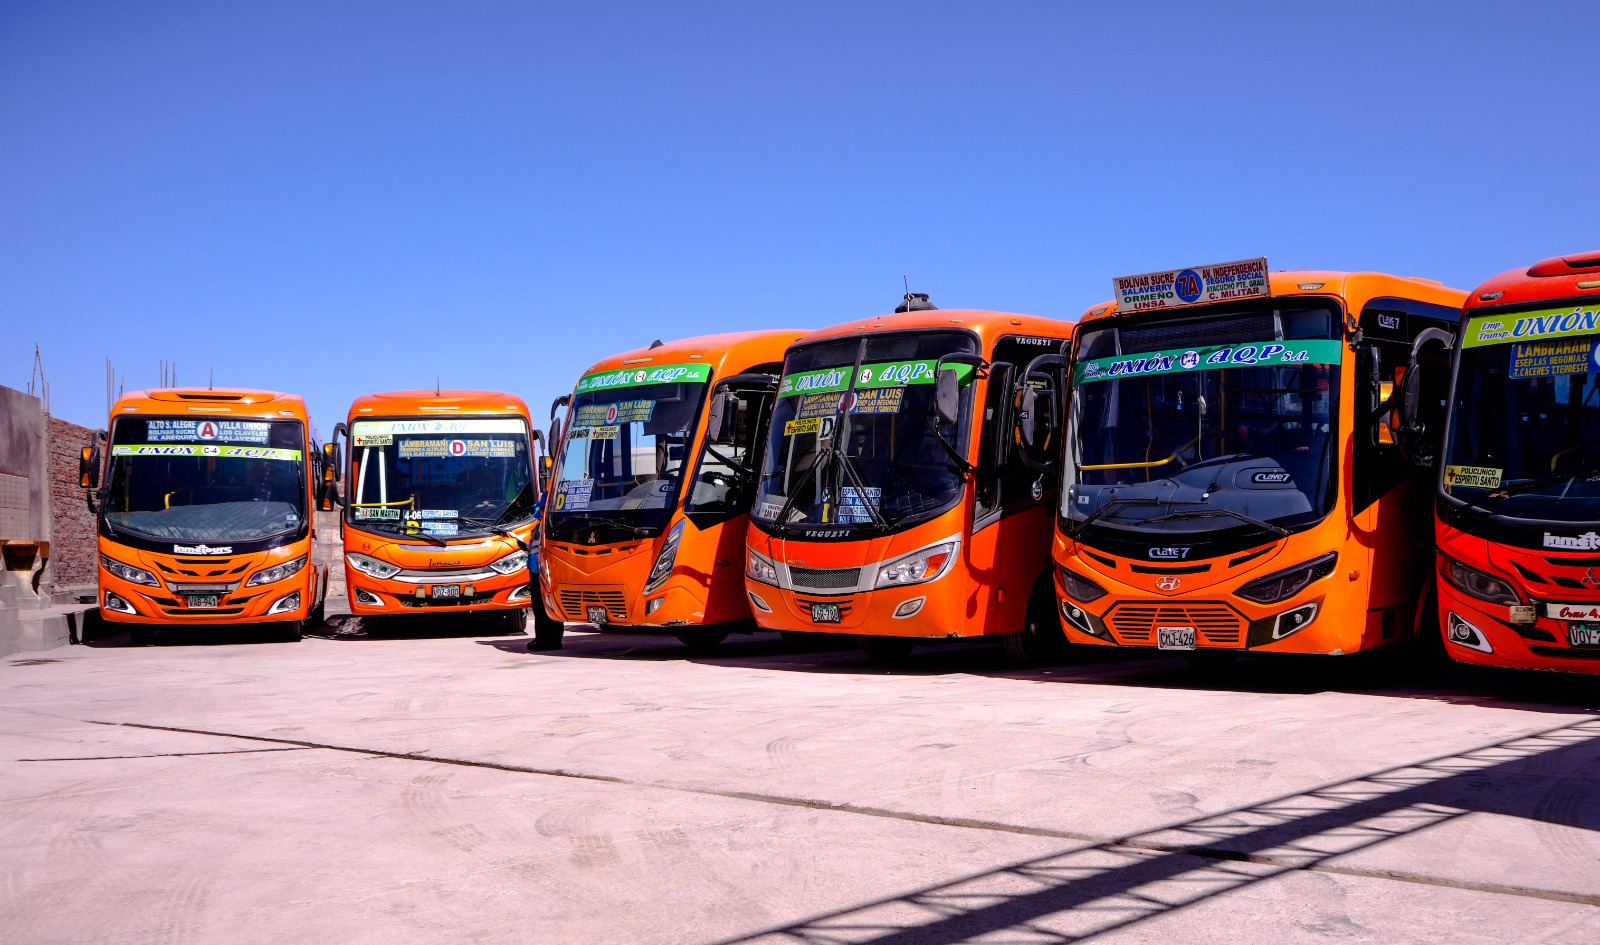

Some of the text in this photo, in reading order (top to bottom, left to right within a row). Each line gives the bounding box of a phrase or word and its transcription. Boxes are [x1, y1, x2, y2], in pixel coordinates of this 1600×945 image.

[1202, 261, 1264, 279] AV. INDEPENDENCIA
[1119, 273, 1175, 289] BOLIVAR SUCRE
[1206, 272, 1264, 286] SEGURO SOCIAL
[1206, 278, 1264, 292] AYACUCHO PTE. GRAU
[1122, 284, 1173, 296] SALAVERRY
[1178, 275, 1200, 297] 7A
[1220, 287, 1260, 298] MILITAR
[1124, 291, 1174, 304] ORMEÑO
[1134, 300, 1166, 310] UNSA
[1482, 322, 1503, 331] Emp.
[1512, 307, 1600, 337] UNIÓN
[1478, 330, 1510, 340] Transp.
[1517, 339, 1591, 358] LAMBRAMANI
[1108, 353, 1178, 376] UNIÓN
[1206, 344, 1285, 365] AQP
[1550, 354, 1588, 364] BEGONIAS
[646, 368, 687, 382] AQP
[795, 368, 846, 391] UNIÓN
[878, 363, 928, 383] AQP
[859, 388, 903, 400] SAN LUIS
[620, 400, 652, 410] SAN LUIS
[607, 408, 616, 420] D
[148, 420, 196, 430] ALTO S. ALEGRE
[200, 421, 215, 437] A
[219, 421, 268, 430] VILLA UNION
[819, 418, 834, 438] D
[452, 441, 465, 455] D
[1460, 468, 1496, 476] POLICLINICO
[1454, 474, 1500, 487] ESPIRITU SANTO
[556, 494, 565, 510] D
[404, 510, 422, 520] 4-06
[1160, 633, 1194, 646] CMJ-426
